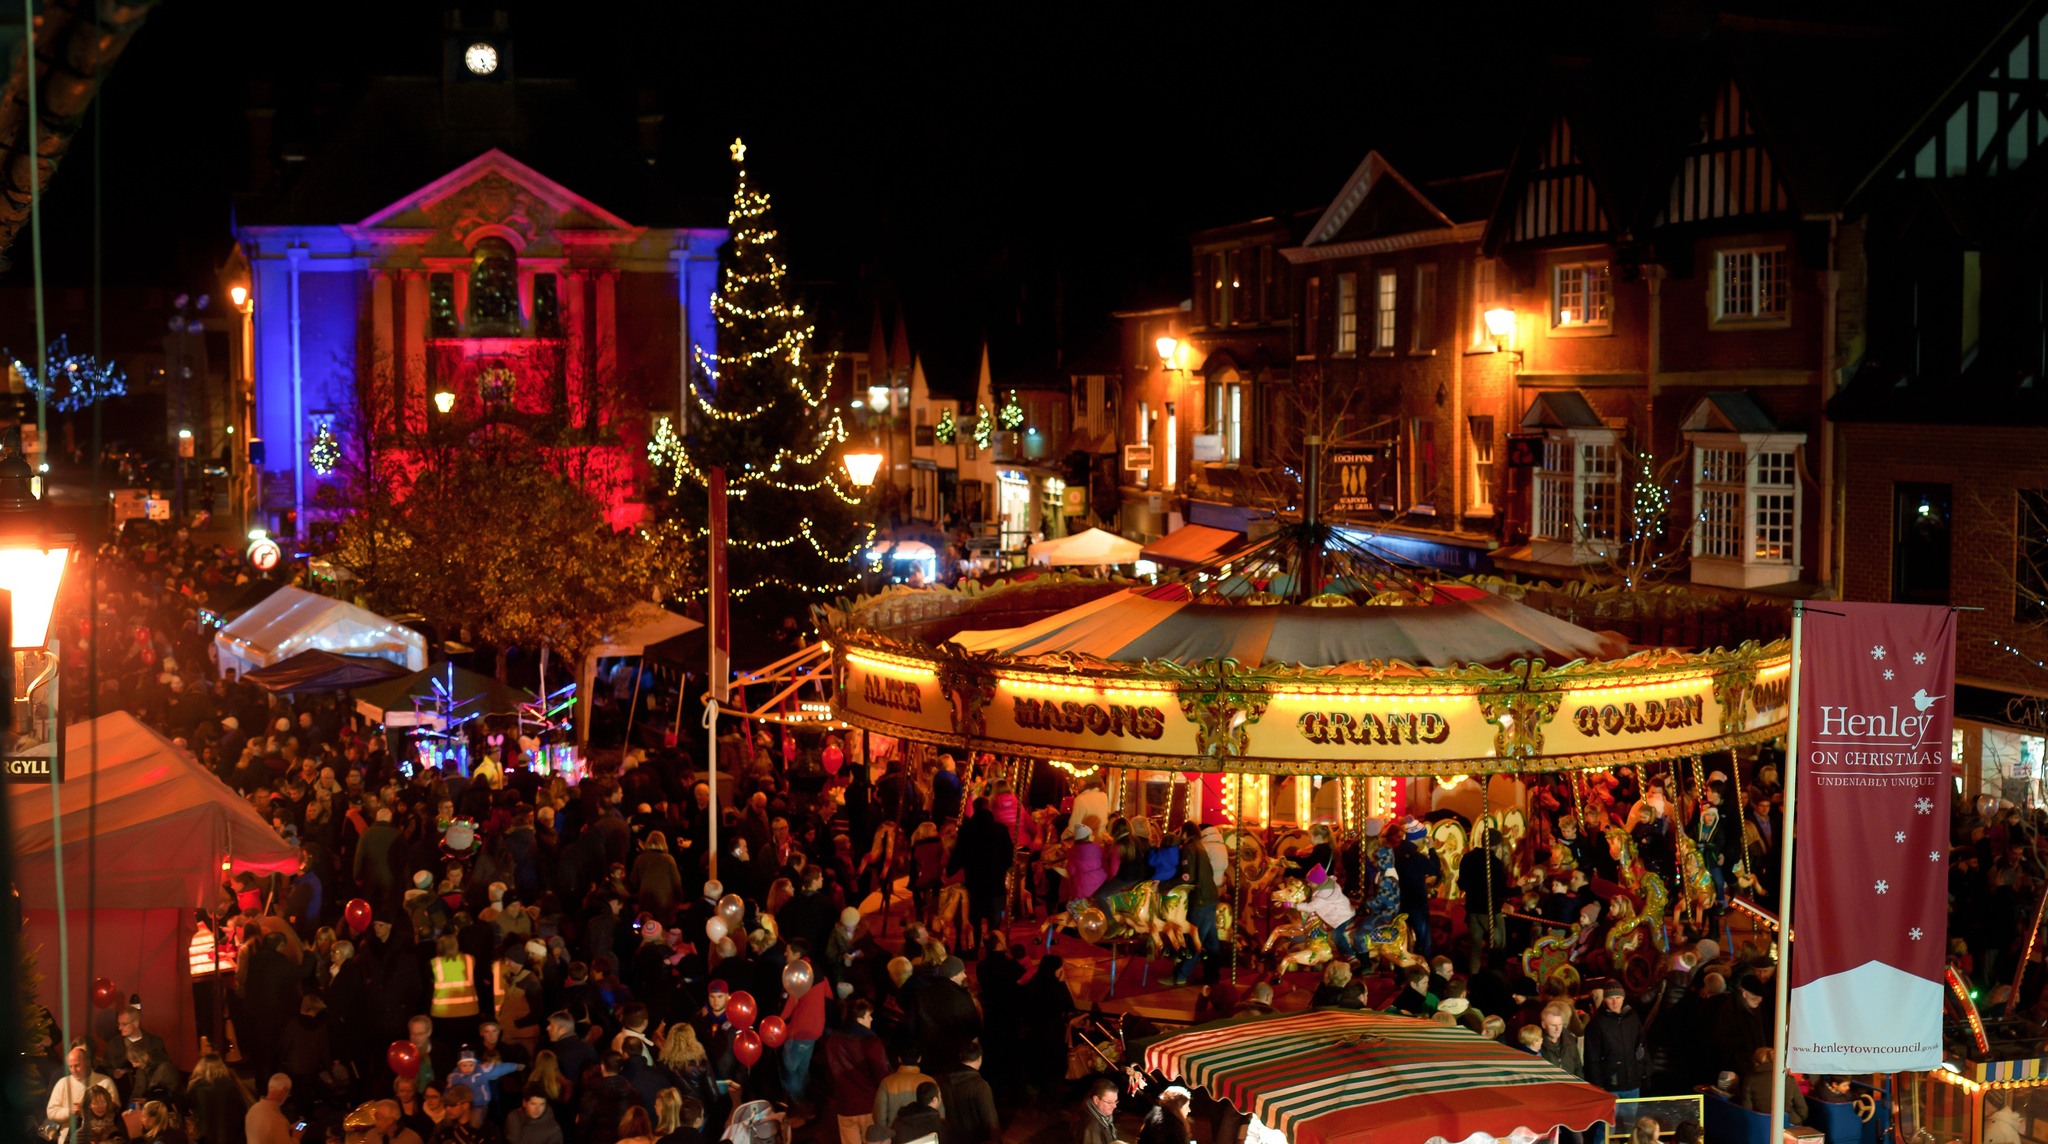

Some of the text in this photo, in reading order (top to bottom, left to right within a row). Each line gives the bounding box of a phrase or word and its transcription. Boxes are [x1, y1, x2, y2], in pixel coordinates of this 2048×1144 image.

[1013, 696, 1165, 741] MASONS
[1296, 712, 1450, 745] GRAND
[1573, 693, 1703, 738] GOLDEN
[1819, 706, 1935, 750] Henley
[1811, 751, 1943, 766] ON CHRISTMAS
[1817, 777, 1935, 788] UNDENIABLY UNIQUE
